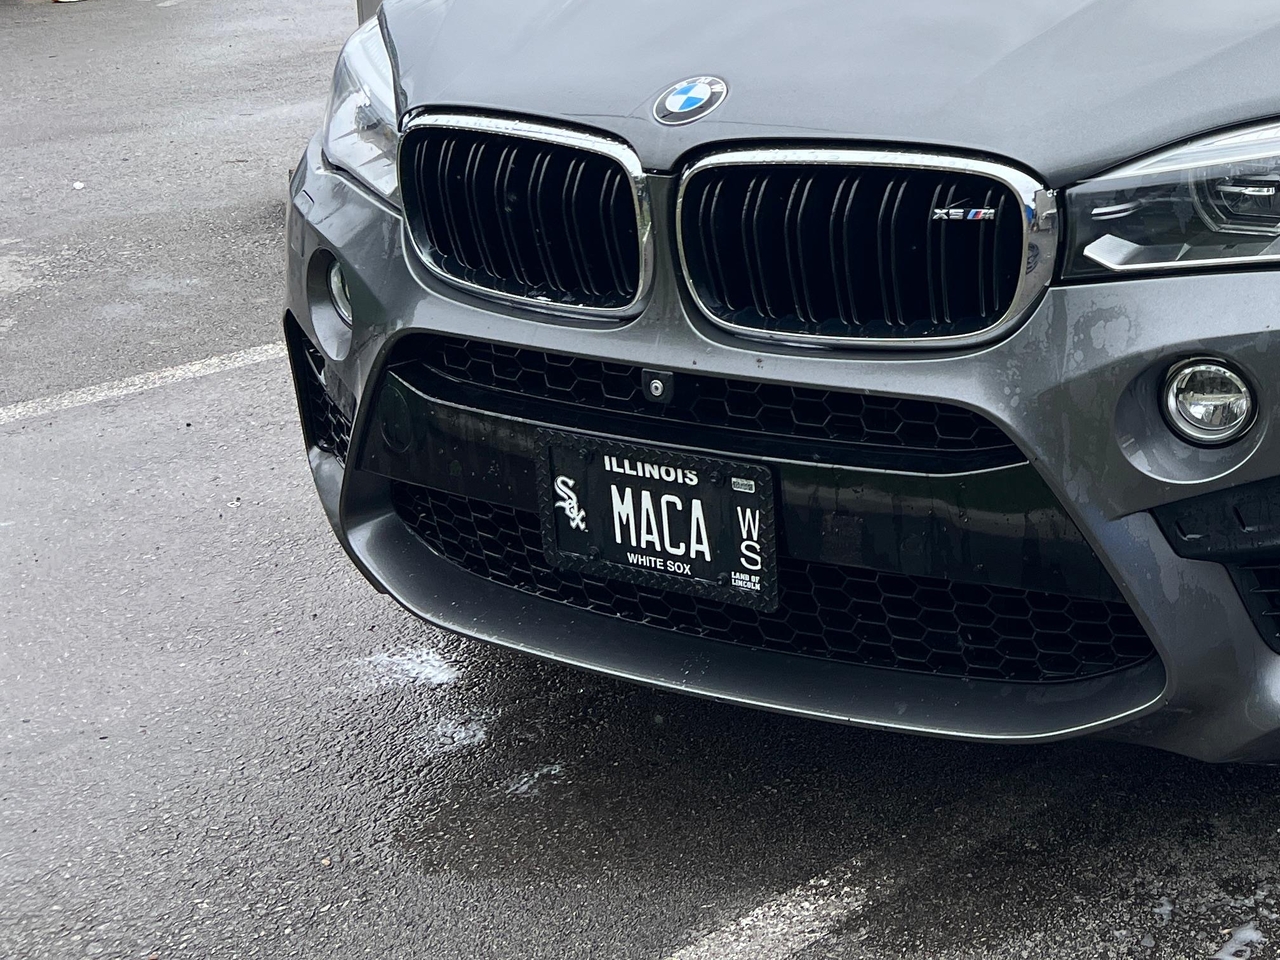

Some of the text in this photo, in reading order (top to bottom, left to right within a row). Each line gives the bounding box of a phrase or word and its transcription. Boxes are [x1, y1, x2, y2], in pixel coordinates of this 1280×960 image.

[604, 455, 699, 486] ILLINOIS
[610, 484, 712, 562] MACA
[627, 552, 692, 576] WHITE SOX
[731, 571, 760, 583] LAND OF
[731, 578, 761, 591] LINCOLN
